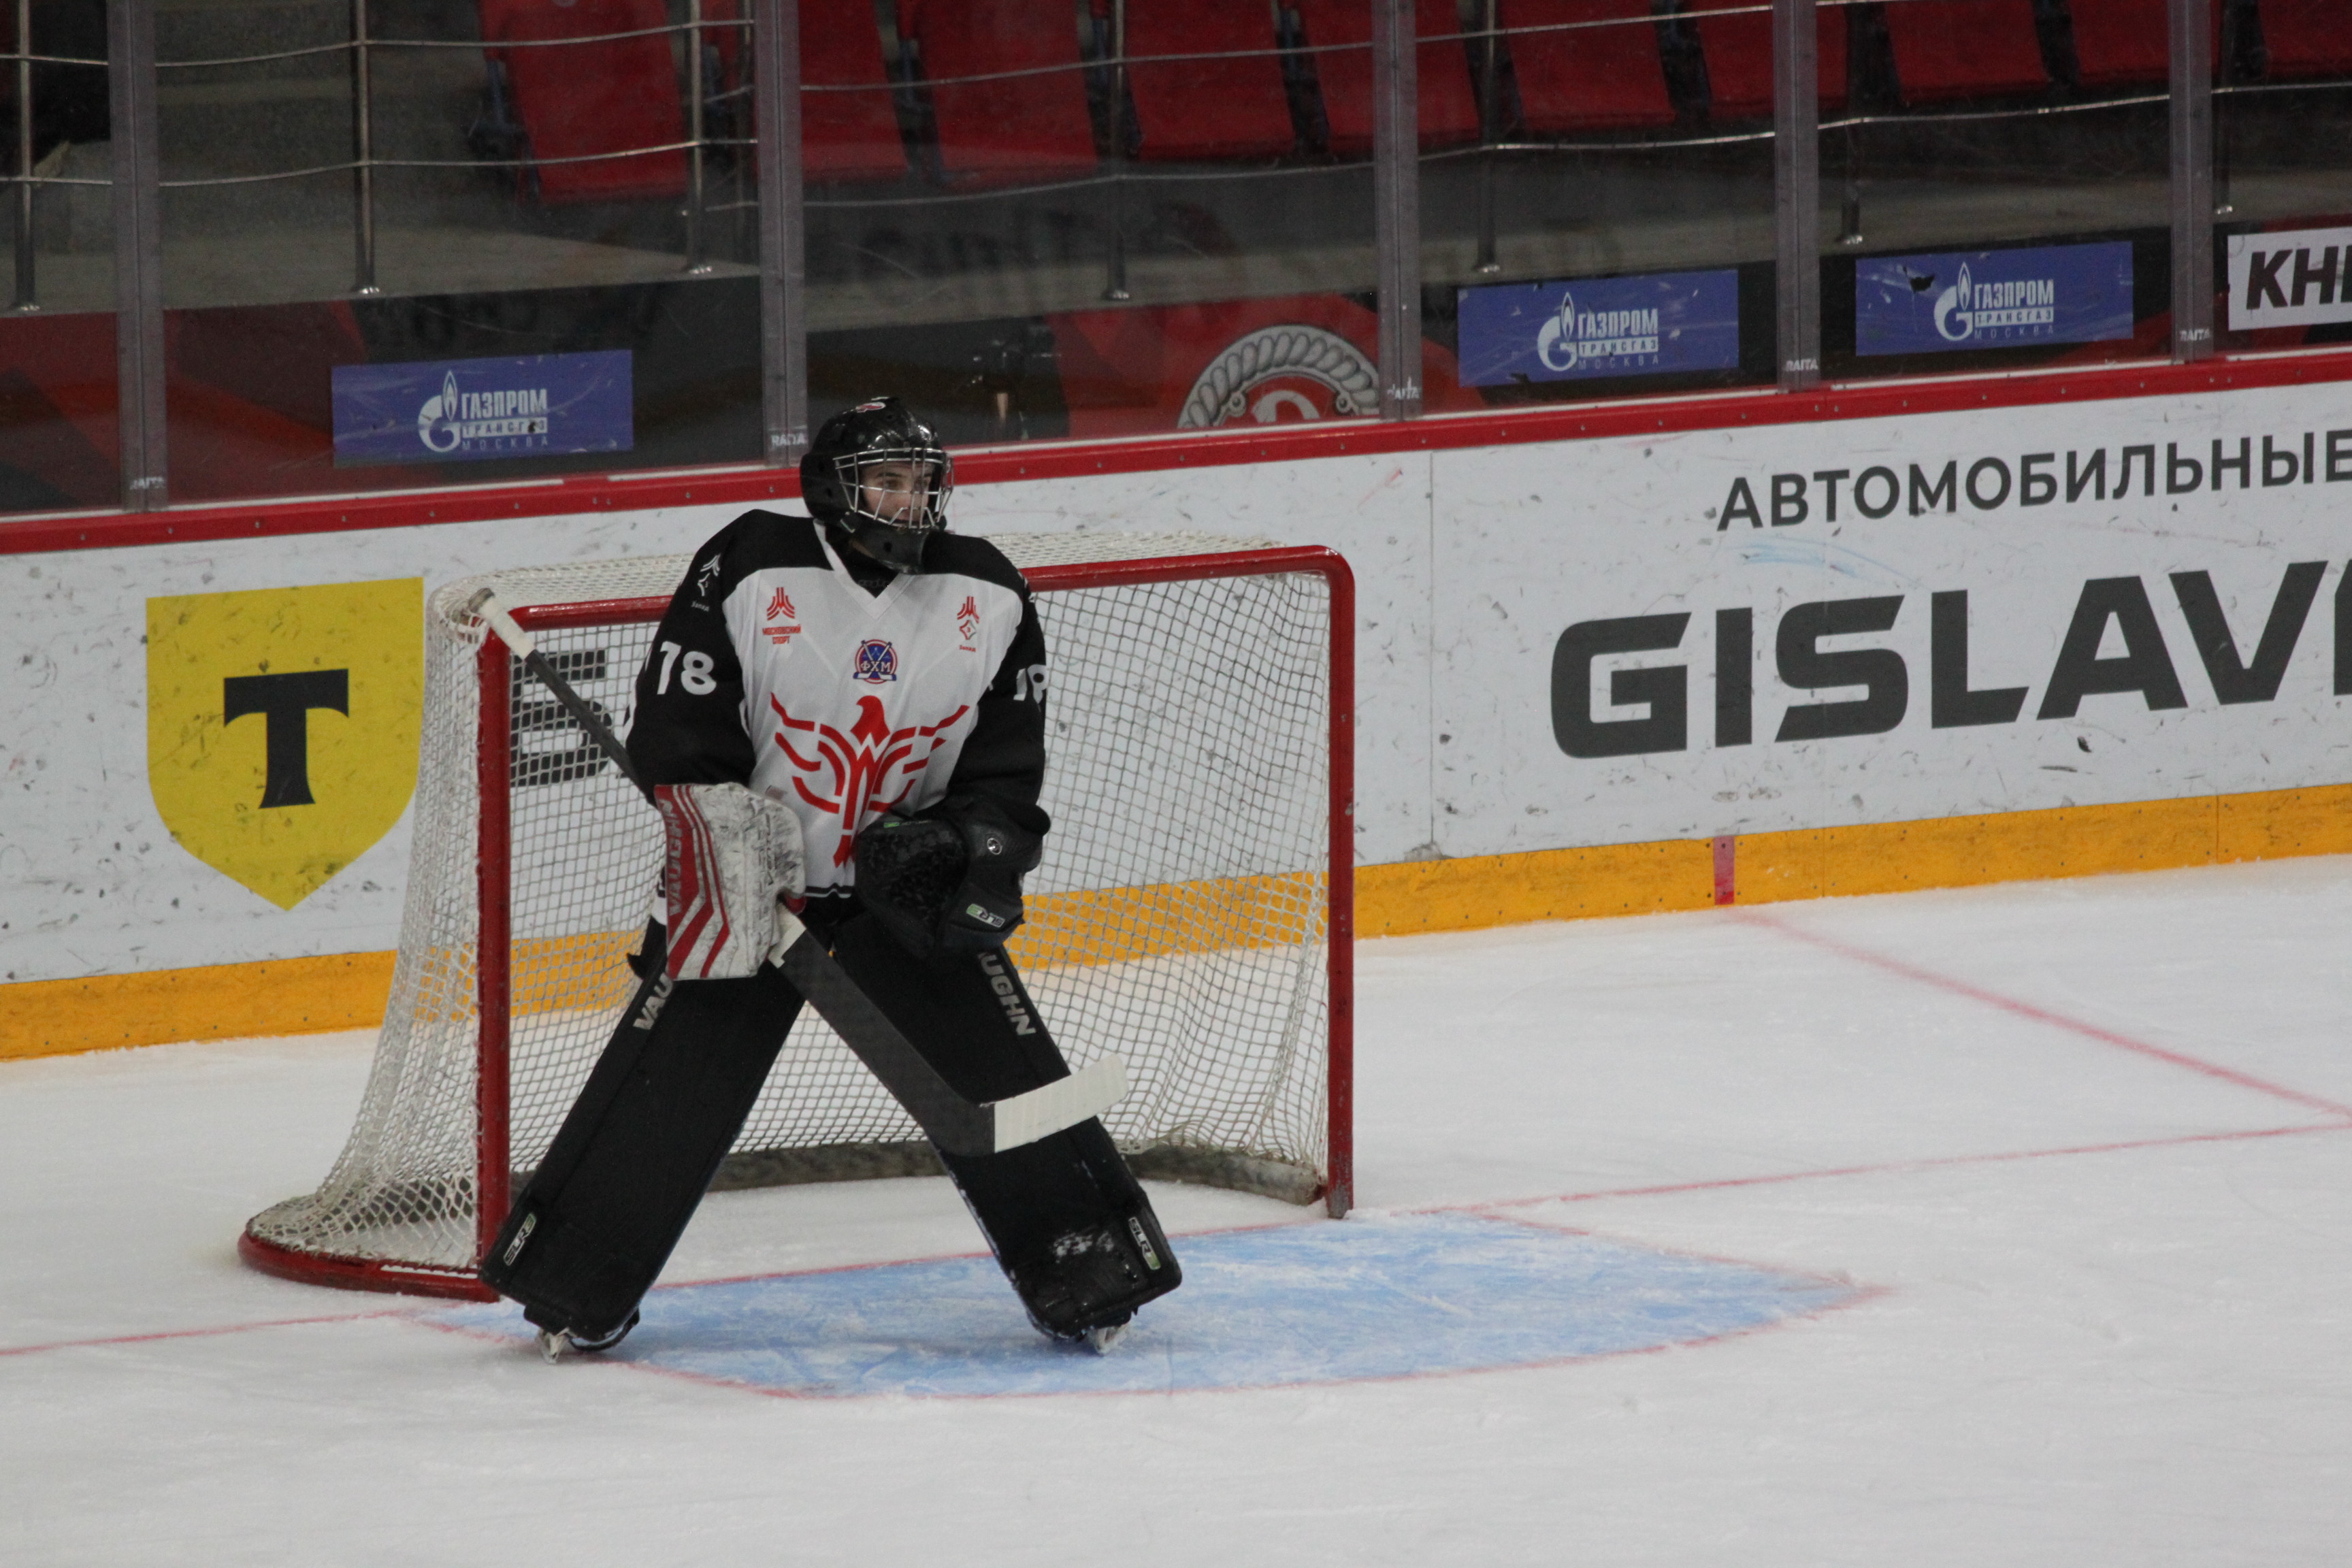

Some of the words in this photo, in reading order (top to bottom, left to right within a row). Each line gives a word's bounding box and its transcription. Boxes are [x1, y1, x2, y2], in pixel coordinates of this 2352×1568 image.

[2247, 246, 2352, 310] КН
[1975, 279, 2054, 310] ГАЗПРОМ
[1578, 308, 1659, 340] ГАЗПРОМ
[1975, 325, 2053, 340] МОСКВА
[1976, 310, 2052, 325] ТРАНСГАЗ
[1578, 355, 1659, 370] МОСКВА
[1580, 340, 1657, 355] ТРАНСГАЗ
[461, 387, 547, 419] ГАЗПРОМ
[461, 435, 547, 451] МОСКВА
[1716, 429, 2352, 532] АВТОМОБИЛЬНЫЕ
[657, 640, 717, 695] 18
[860, 660, 891, 672] ФХМ
[1550, 558, 2352, 760] GISLAV
[658, 798, 683, 917] VAUGHN
[977, 952, 1036, 1036] UGHN
